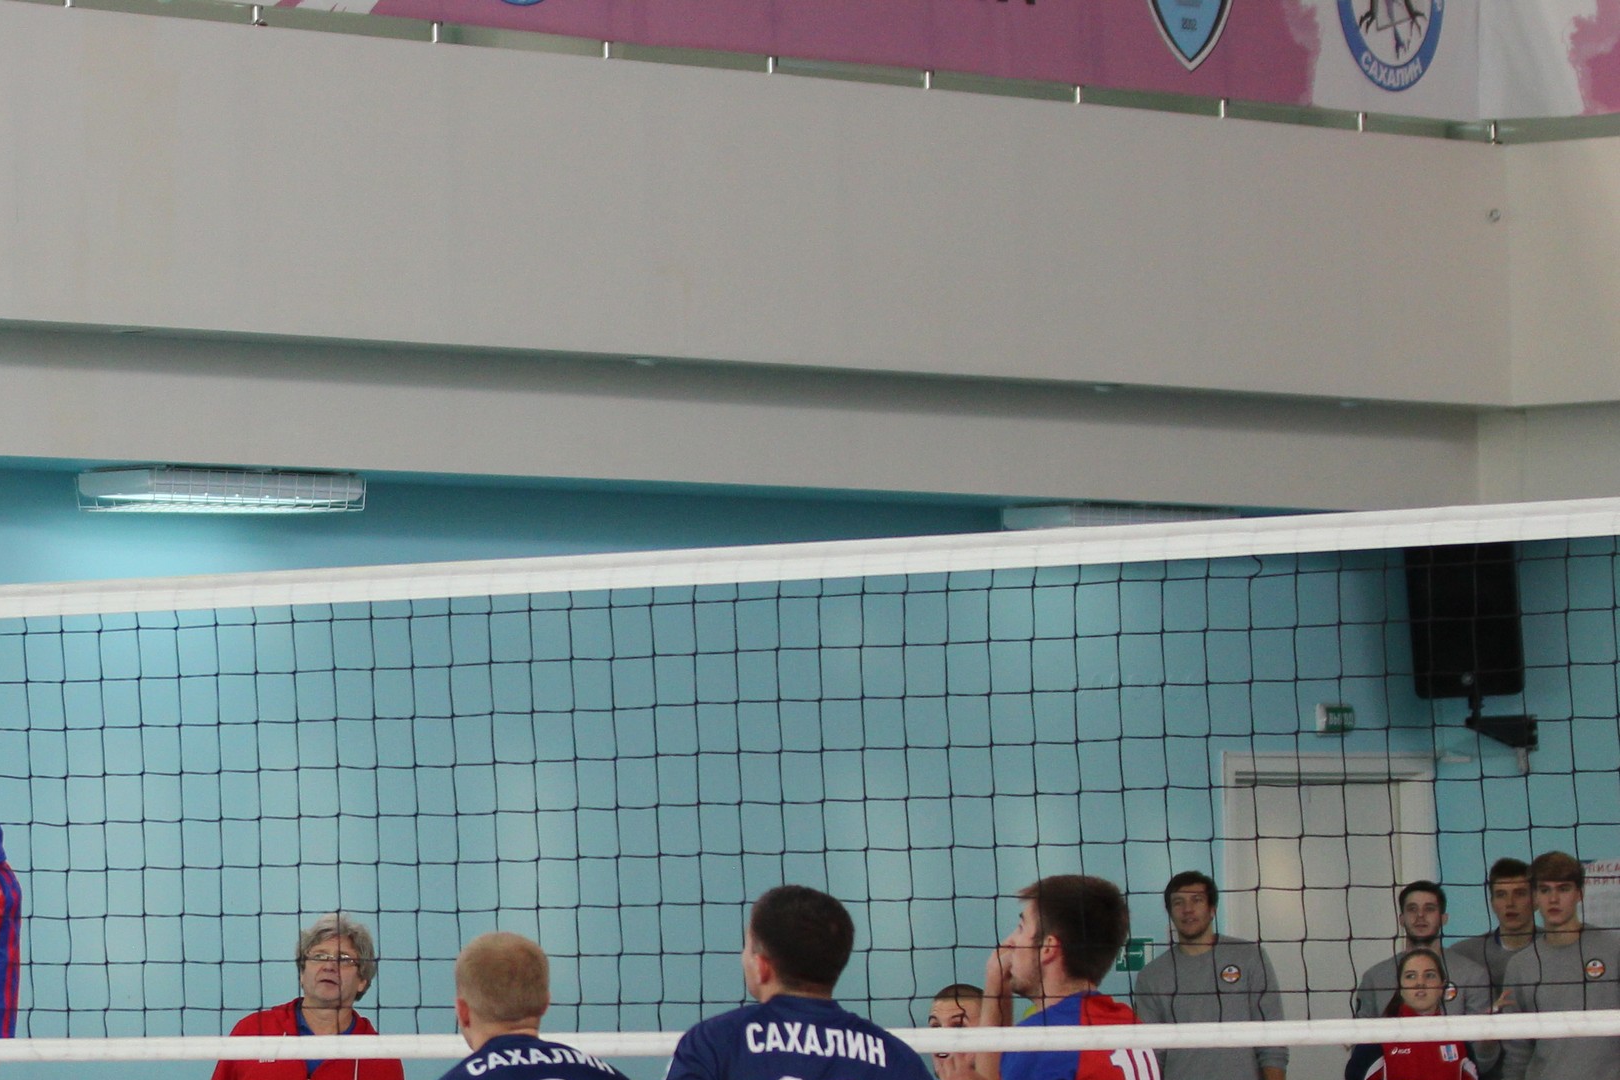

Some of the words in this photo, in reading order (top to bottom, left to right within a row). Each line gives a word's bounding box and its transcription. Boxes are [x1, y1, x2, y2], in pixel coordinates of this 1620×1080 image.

[1361, 51, 1423, 87] САХАЛИН
[465, 1047, 616, 1077] САХАЛИН
[746, 1021, 887, 1068] САХАЛИН
